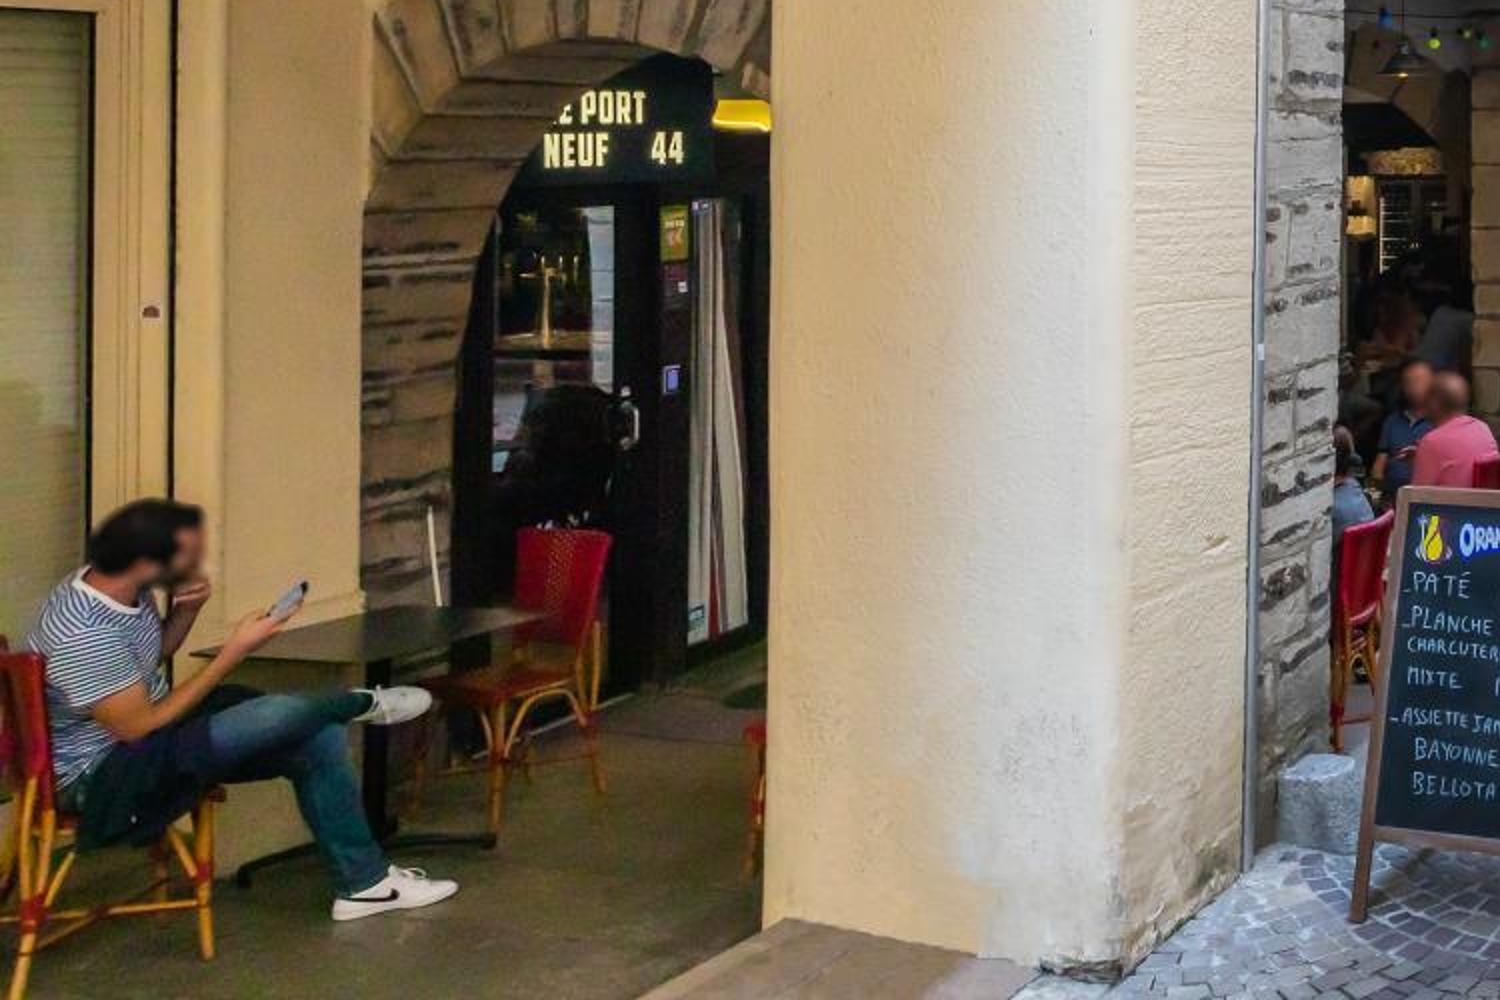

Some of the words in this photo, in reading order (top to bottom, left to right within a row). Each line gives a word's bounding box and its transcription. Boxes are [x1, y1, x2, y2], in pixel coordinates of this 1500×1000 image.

[580, 90, 647, 125] PORT
[543, 132, 609, 169] NEUF
[650, 131, 685, 166] 44
[1410, 604, 1495, 636] PLANCHE
[1407, 665, 1463, 689] MIXTE
[1401, 707, 1469, 728] ASSIETTE
[1412, 771, 1495, 801] BELLOTA
